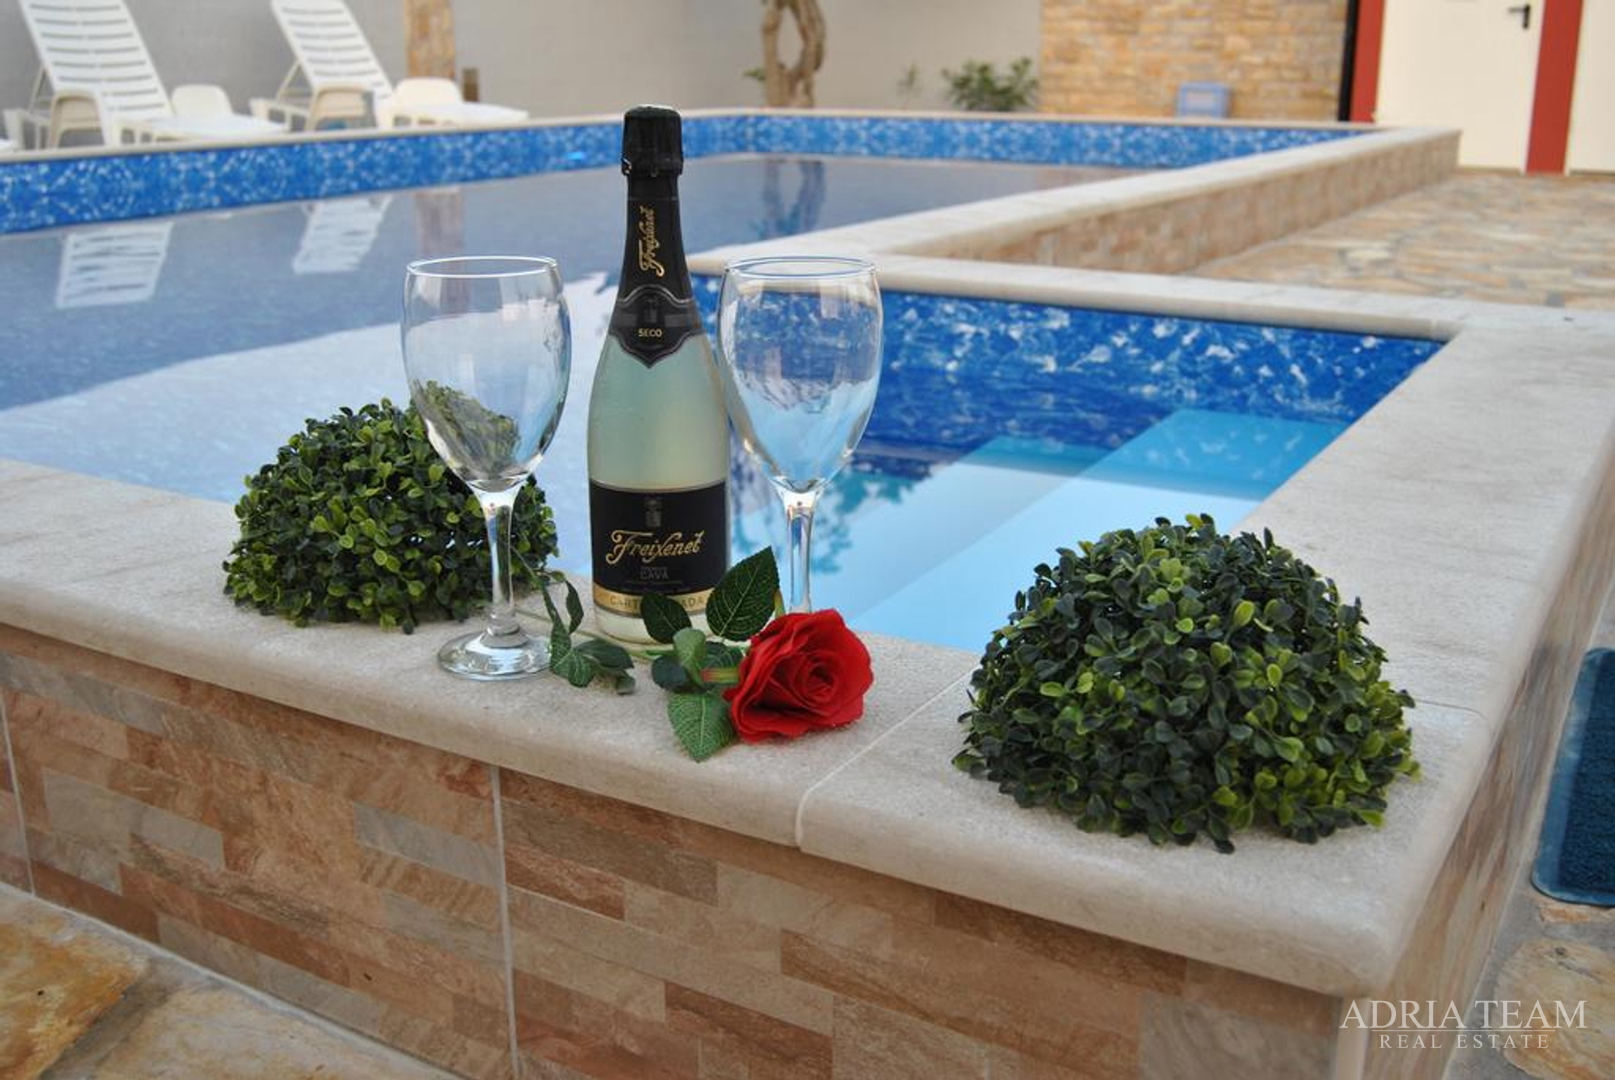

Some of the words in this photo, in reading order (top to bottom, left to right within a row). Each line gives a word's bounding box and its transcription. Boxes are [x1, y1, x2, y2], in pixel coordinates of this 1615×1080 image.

[639, 204, 665, 278] Freixenet
[637, 328, 663, 338] SECO
[605, 529, 705, 565] Freixenet
[610, 595, 641, 609] CART
